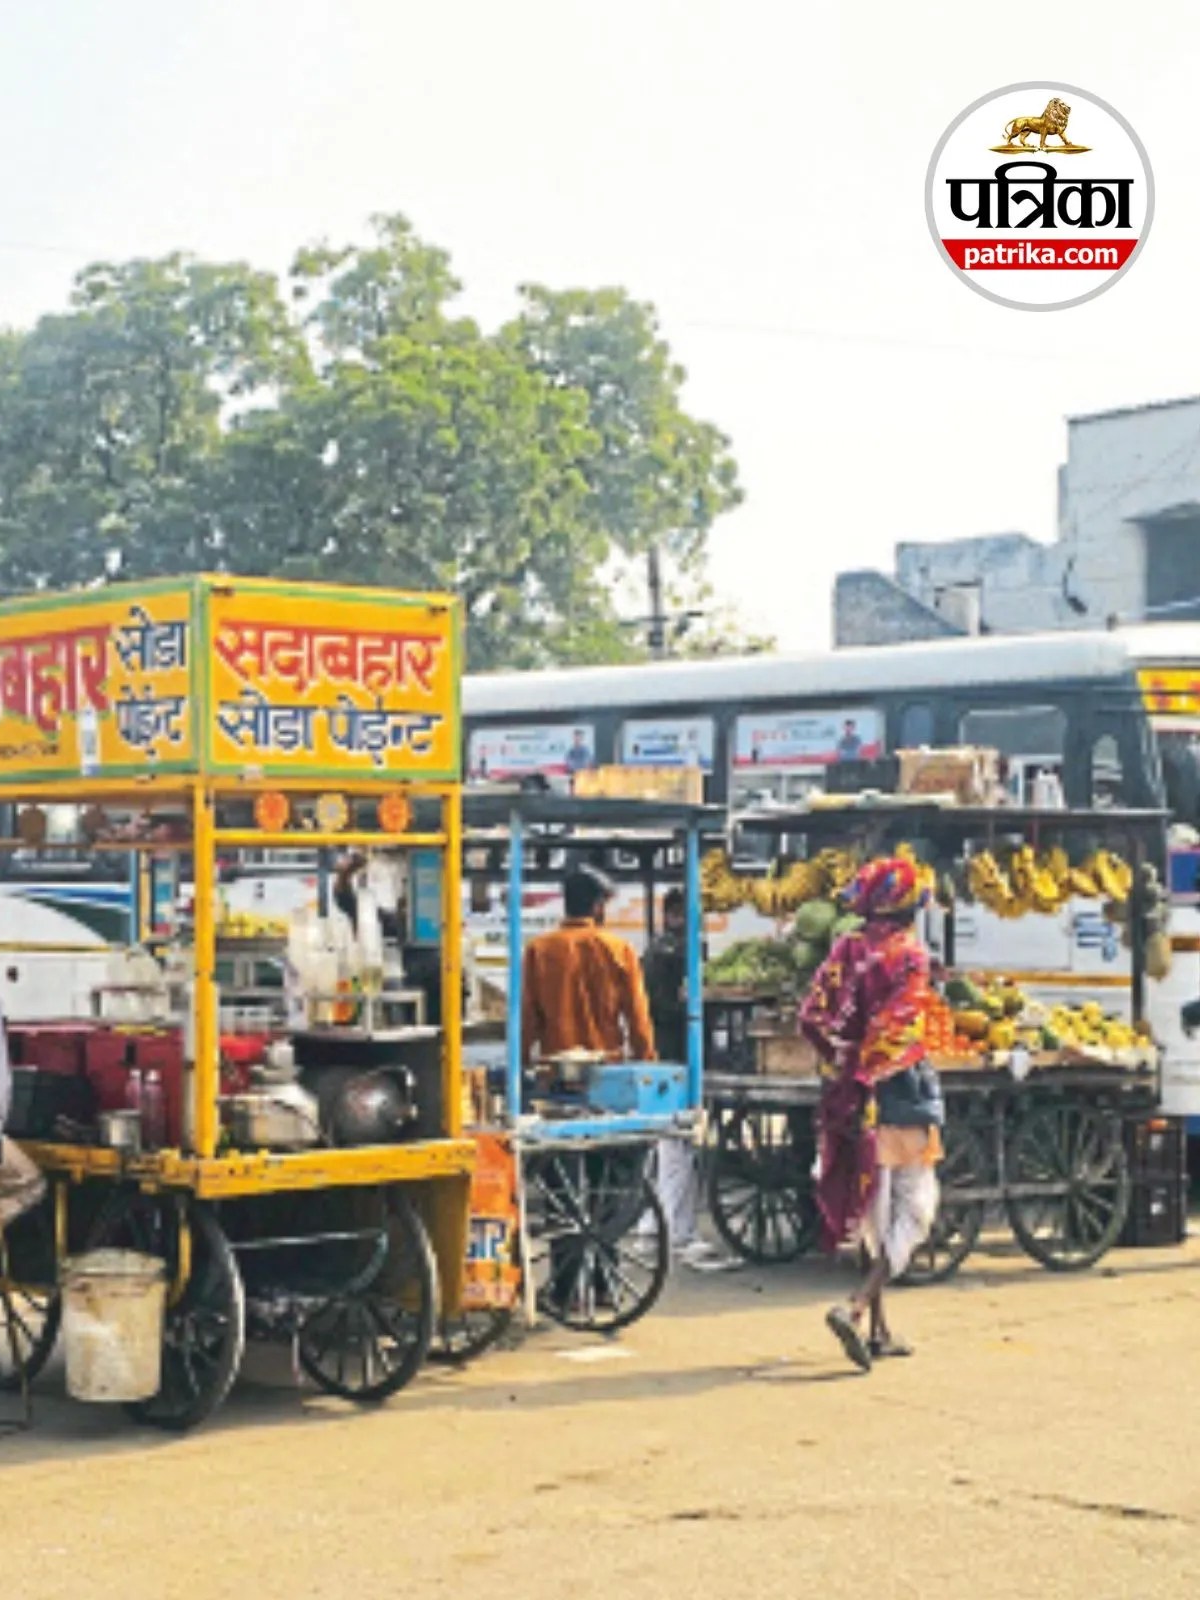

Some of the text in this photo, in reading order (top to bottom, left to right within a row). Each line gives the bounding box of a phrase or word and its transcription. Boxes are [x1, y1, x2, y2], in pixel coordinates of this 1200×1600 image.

[115, 604, 186, 670] सोडा
[213, 619, 442, 692] सदाबहार
[216, 688, 319, 750] सोडा
